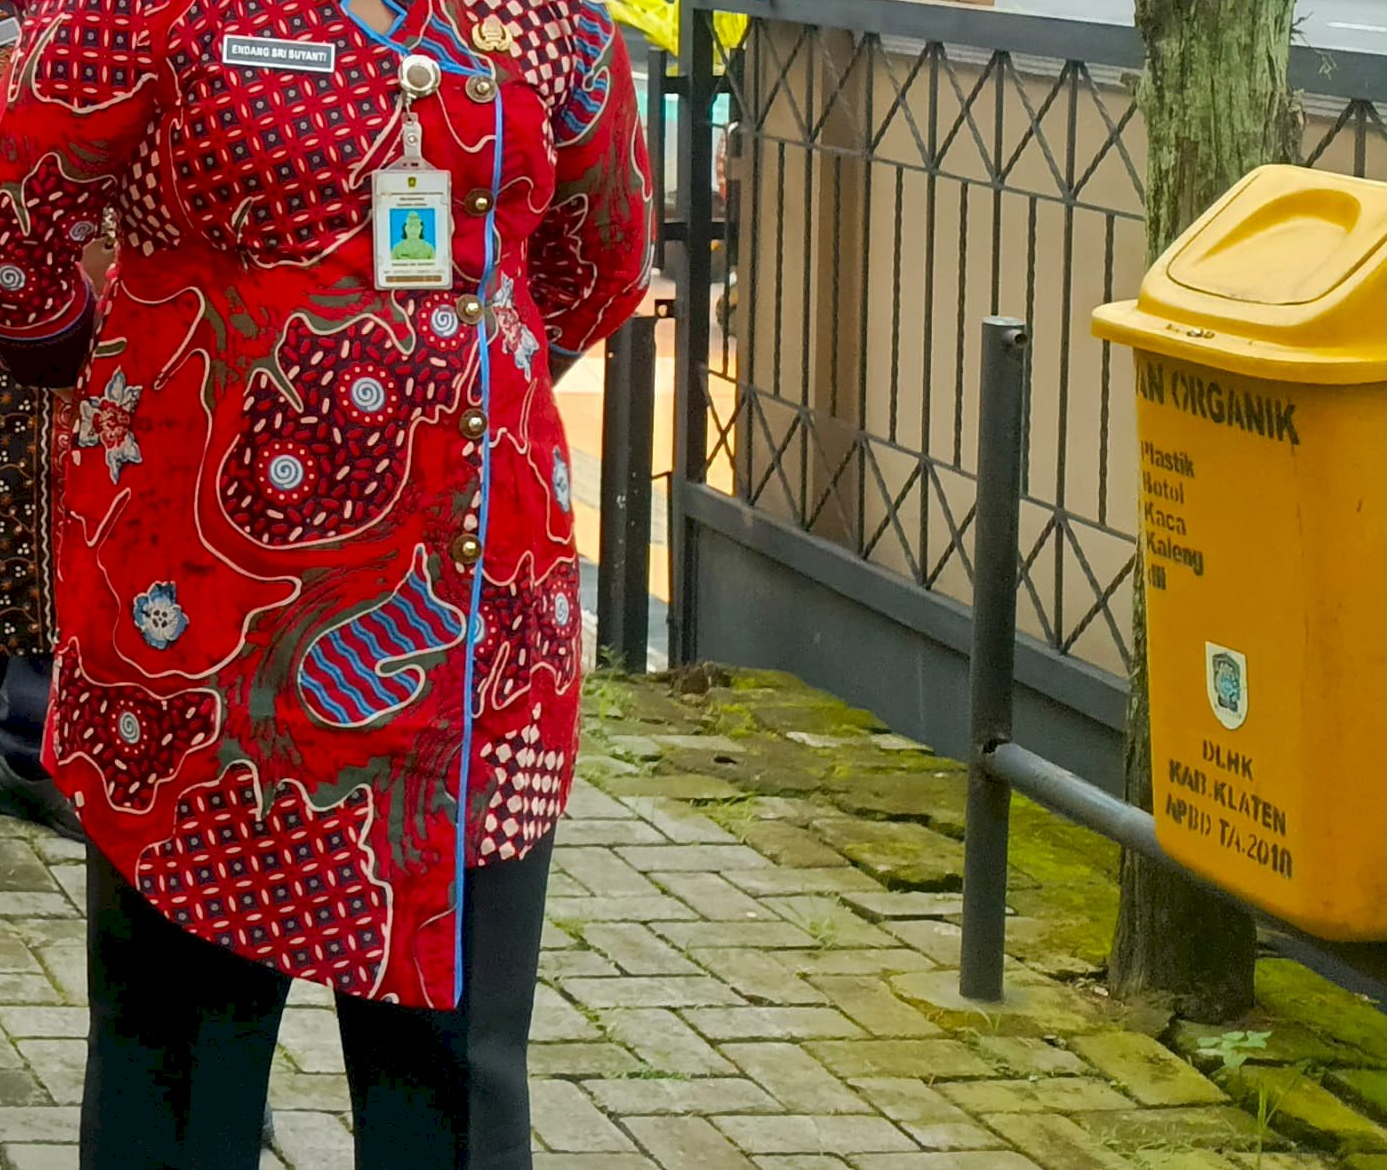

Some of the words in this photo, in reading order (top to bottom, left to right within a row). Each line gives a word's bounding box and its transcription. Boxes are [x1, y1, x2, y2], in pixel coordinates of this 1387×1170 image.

[231, 45, 269, 58] ENDANG
[270, 47, 287, 58] SRI
[288, 48, 327, 62] SUYANTI
[1171, 370, 1300, 446] ORGANIK
[1141, 440, 1195, 478] Plastik
[1144, 502, 1187, 536] Kaca
[1146, 532, 1204, 576] Kaleng
[1202, 739, 1253, 782] DLHK
[1165, 793, 1212, 836] APBD
